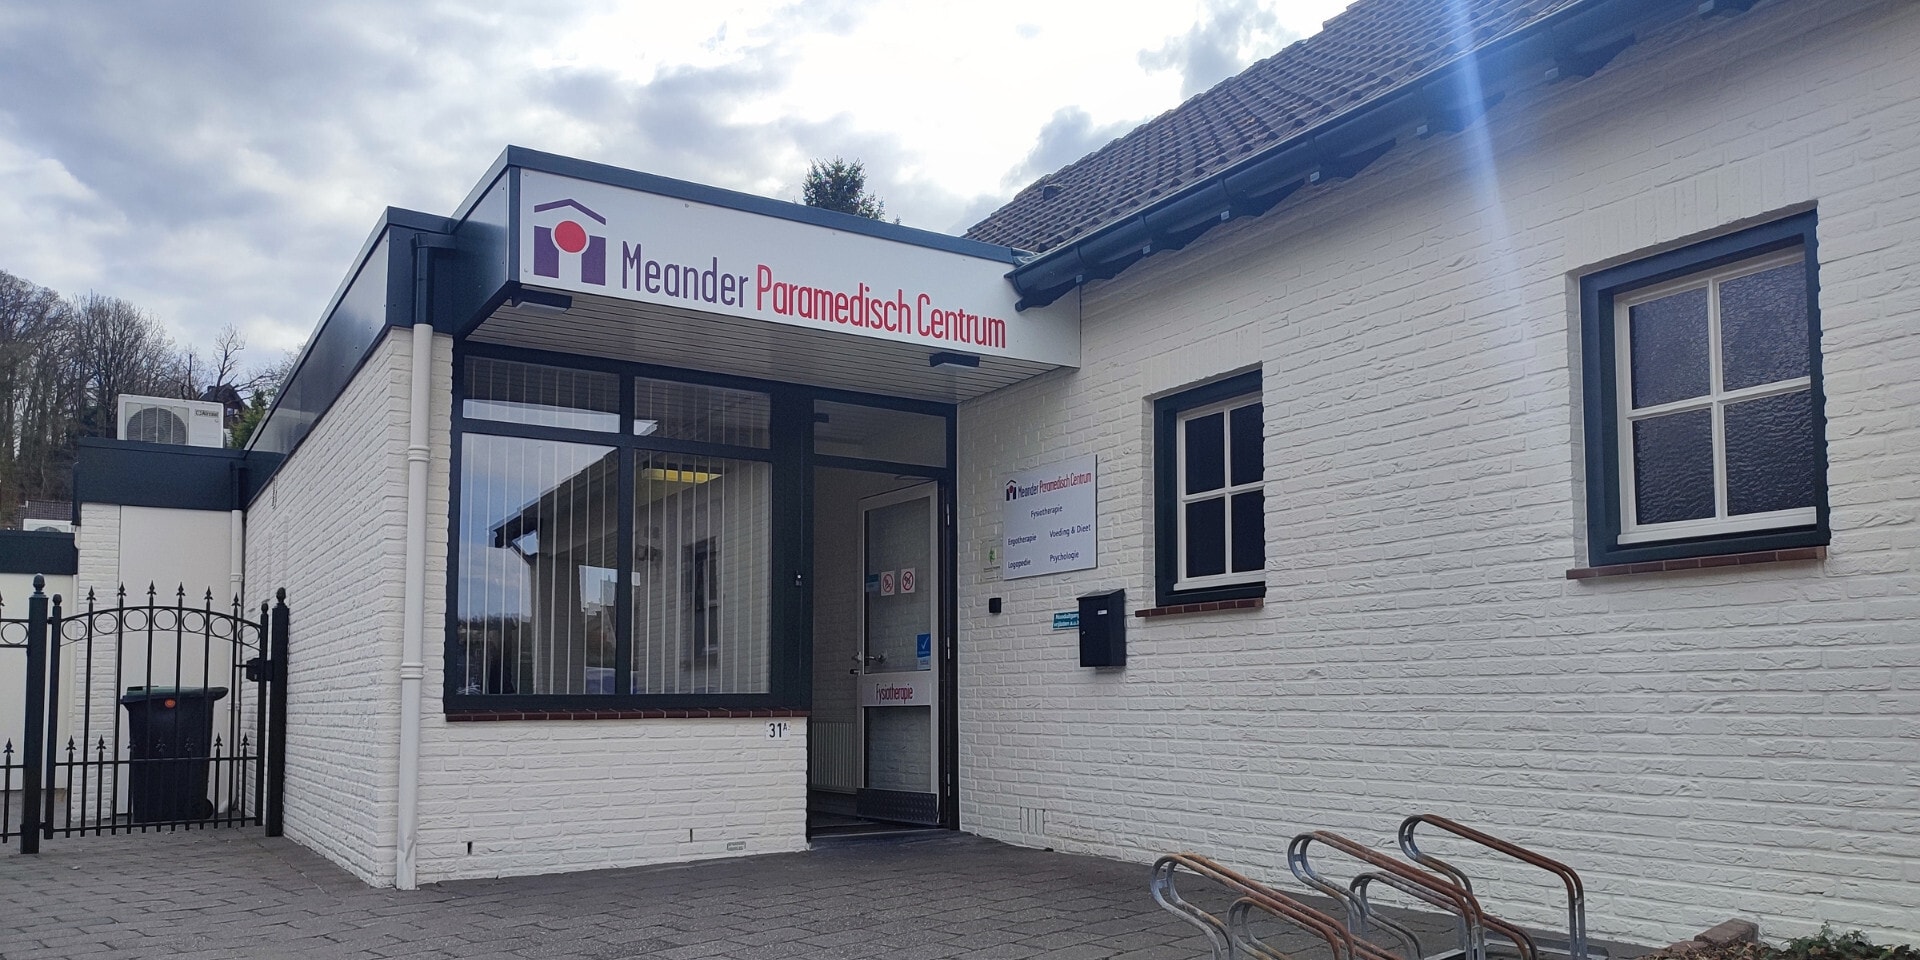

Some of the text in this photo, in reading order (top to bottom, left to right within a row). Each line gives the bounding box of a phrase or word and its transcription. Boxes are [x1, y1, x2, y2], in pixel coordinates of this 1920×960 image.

[621, 241, 1006, 348] Meander Paramedisch Centrum
[1030, 504, 1062, 519] Fysiotherapie
[1049, 524, 1091, 537] Voeding & Dieet
[1008, 534, 1036, 546] Ergotherapie
[1008, 558, 1031, 568] Logopedie
[1049, 550, 1079, 563] Psychologie
[875, 683, 913, 704] Fysiotherapie
